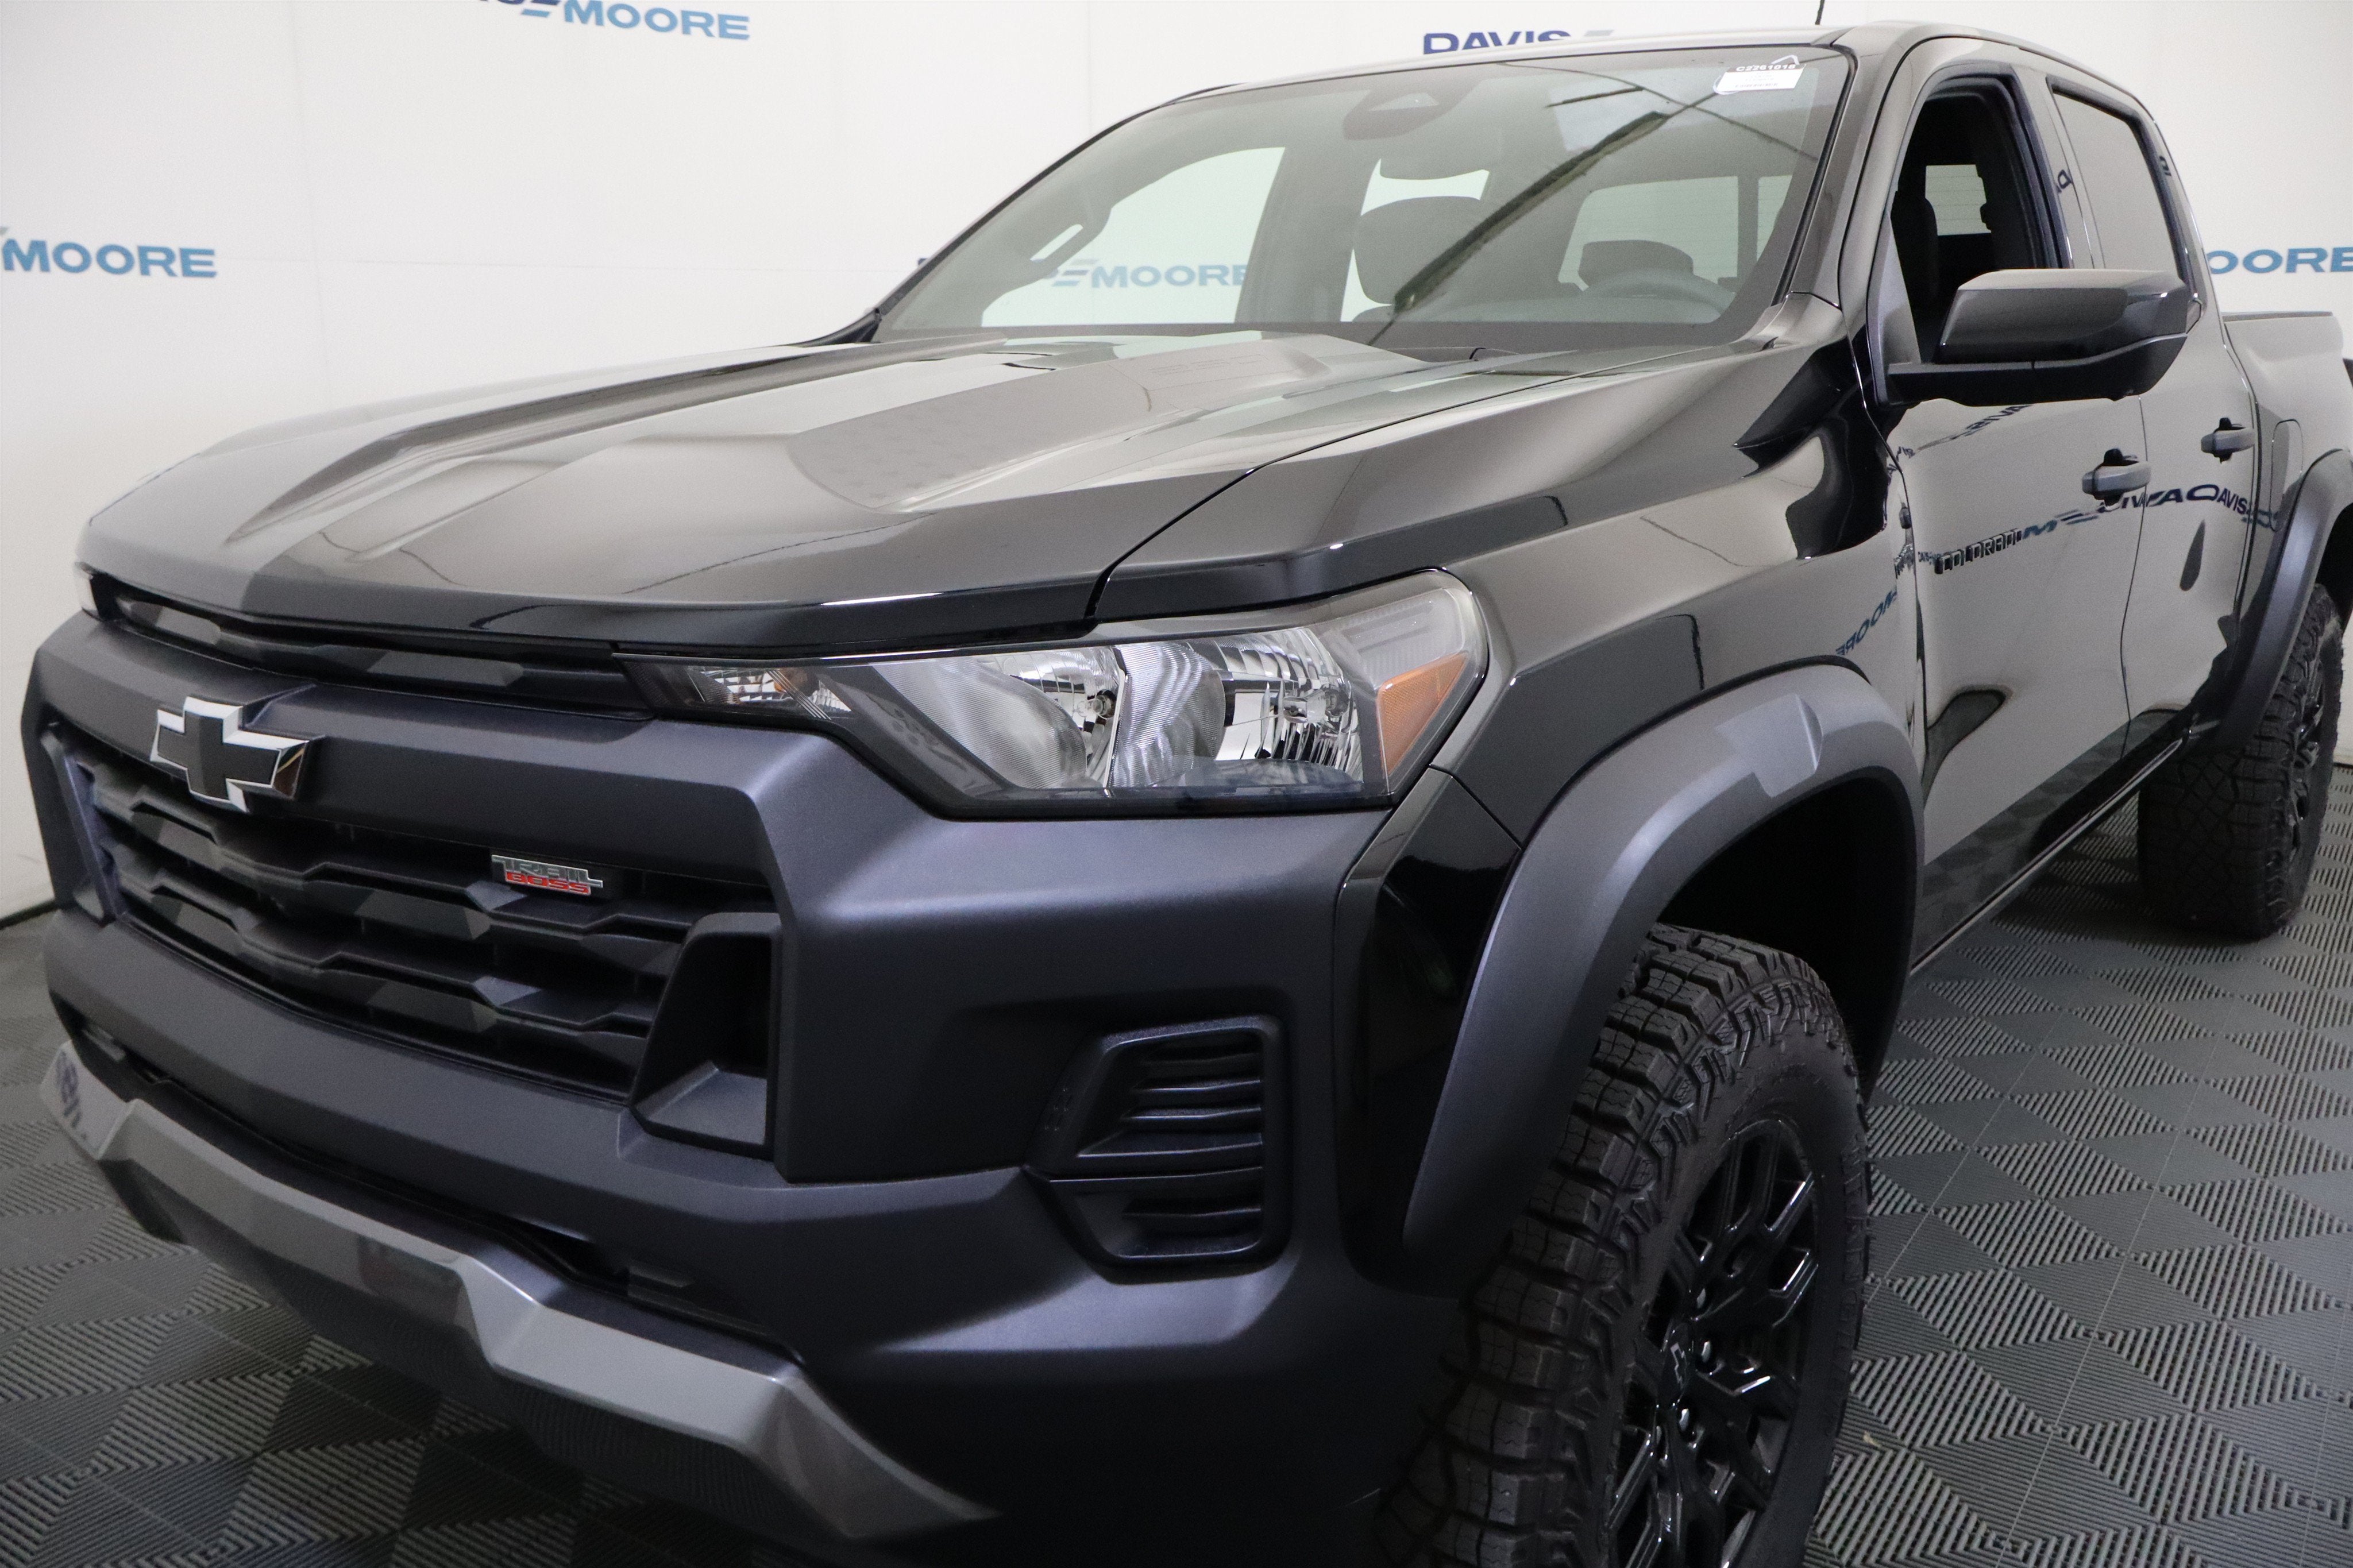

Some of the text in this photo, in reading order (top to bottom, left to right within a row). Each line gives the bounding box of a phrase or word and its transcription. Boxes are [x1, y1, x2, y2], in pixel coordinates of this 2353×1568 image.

[562, 0, 751, 40] MOORE
[2, 239, 218, 278] MOORE
[2207, 246, 2353, 275] OORE
[491, 854, 603, 888] TRAIL
[505, 871, 591, 896] BOSS
